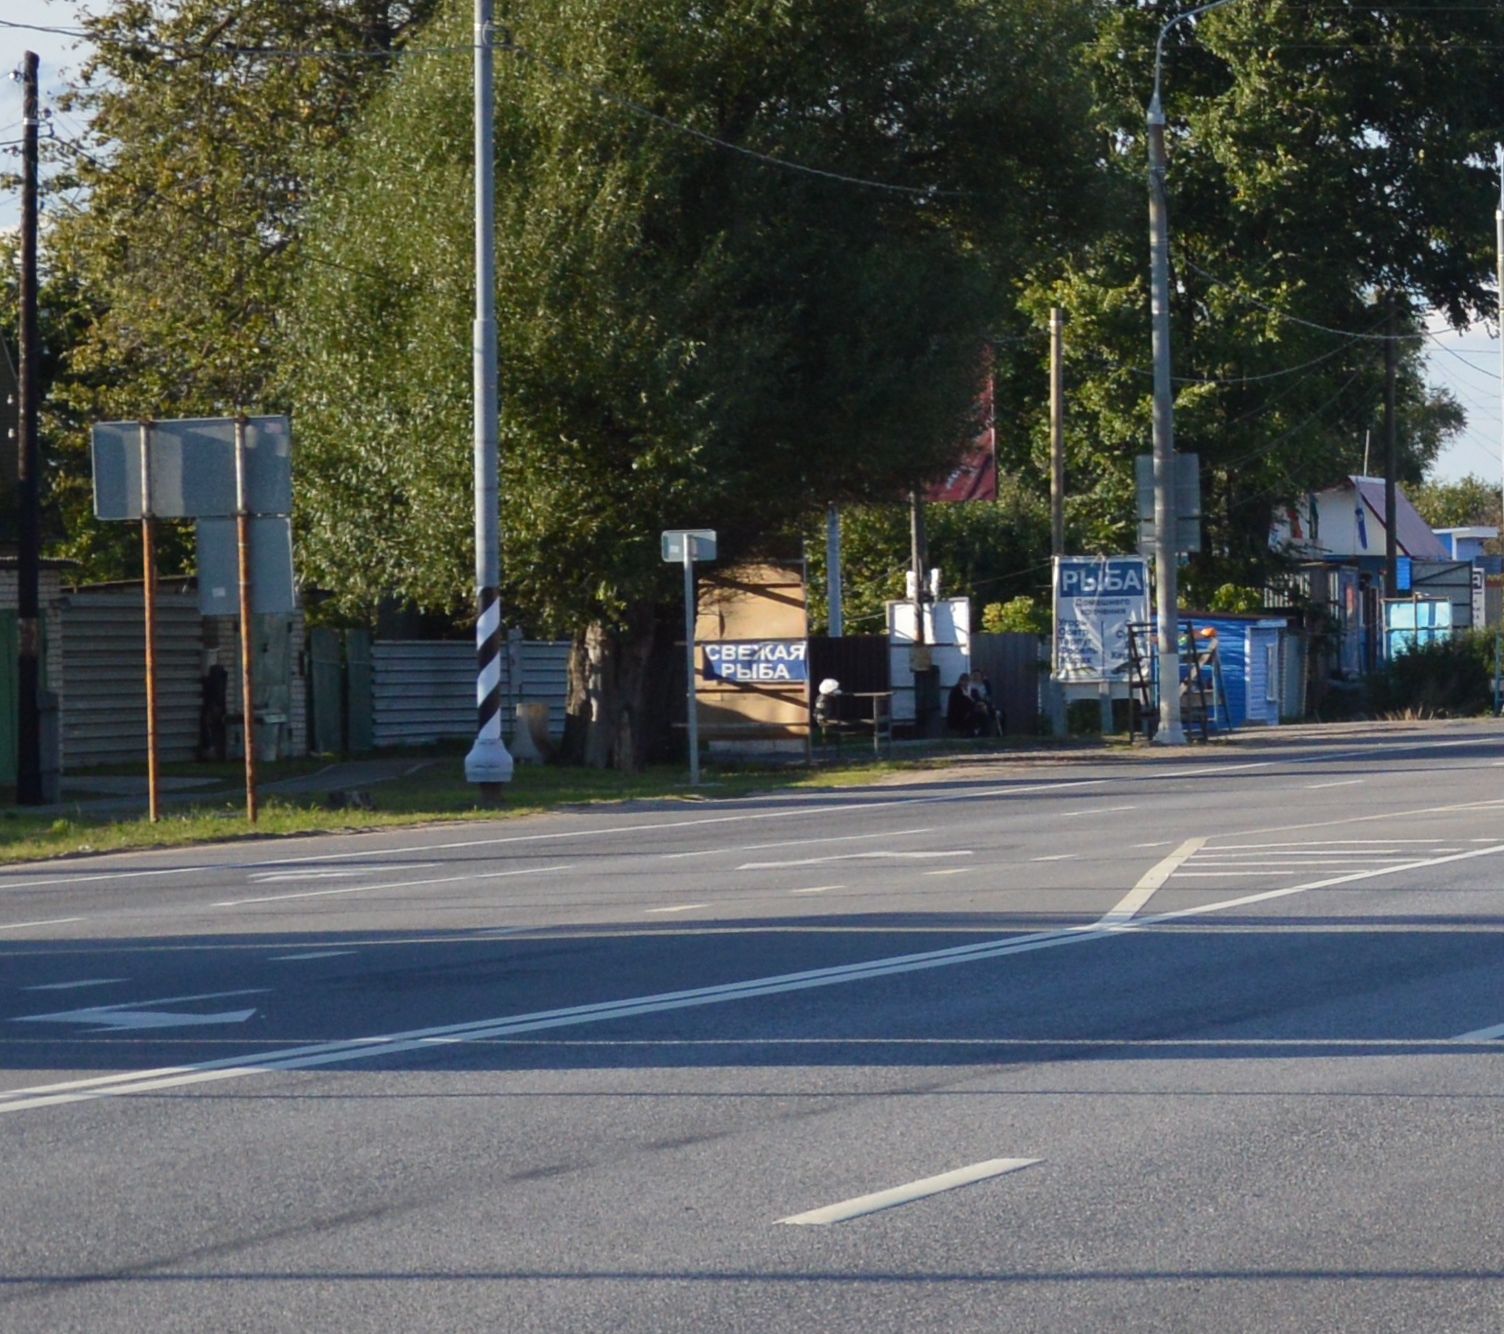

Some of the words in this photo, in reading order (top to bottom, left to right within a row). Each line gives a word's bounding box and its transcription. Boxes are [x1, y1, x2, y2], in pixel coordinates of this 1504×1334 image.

[1062, 569, 1142, 592] РЫБА
[705, 644, 806, 661] СВЕЖАЯ
[721, 663, 790, 679] РЫБА
